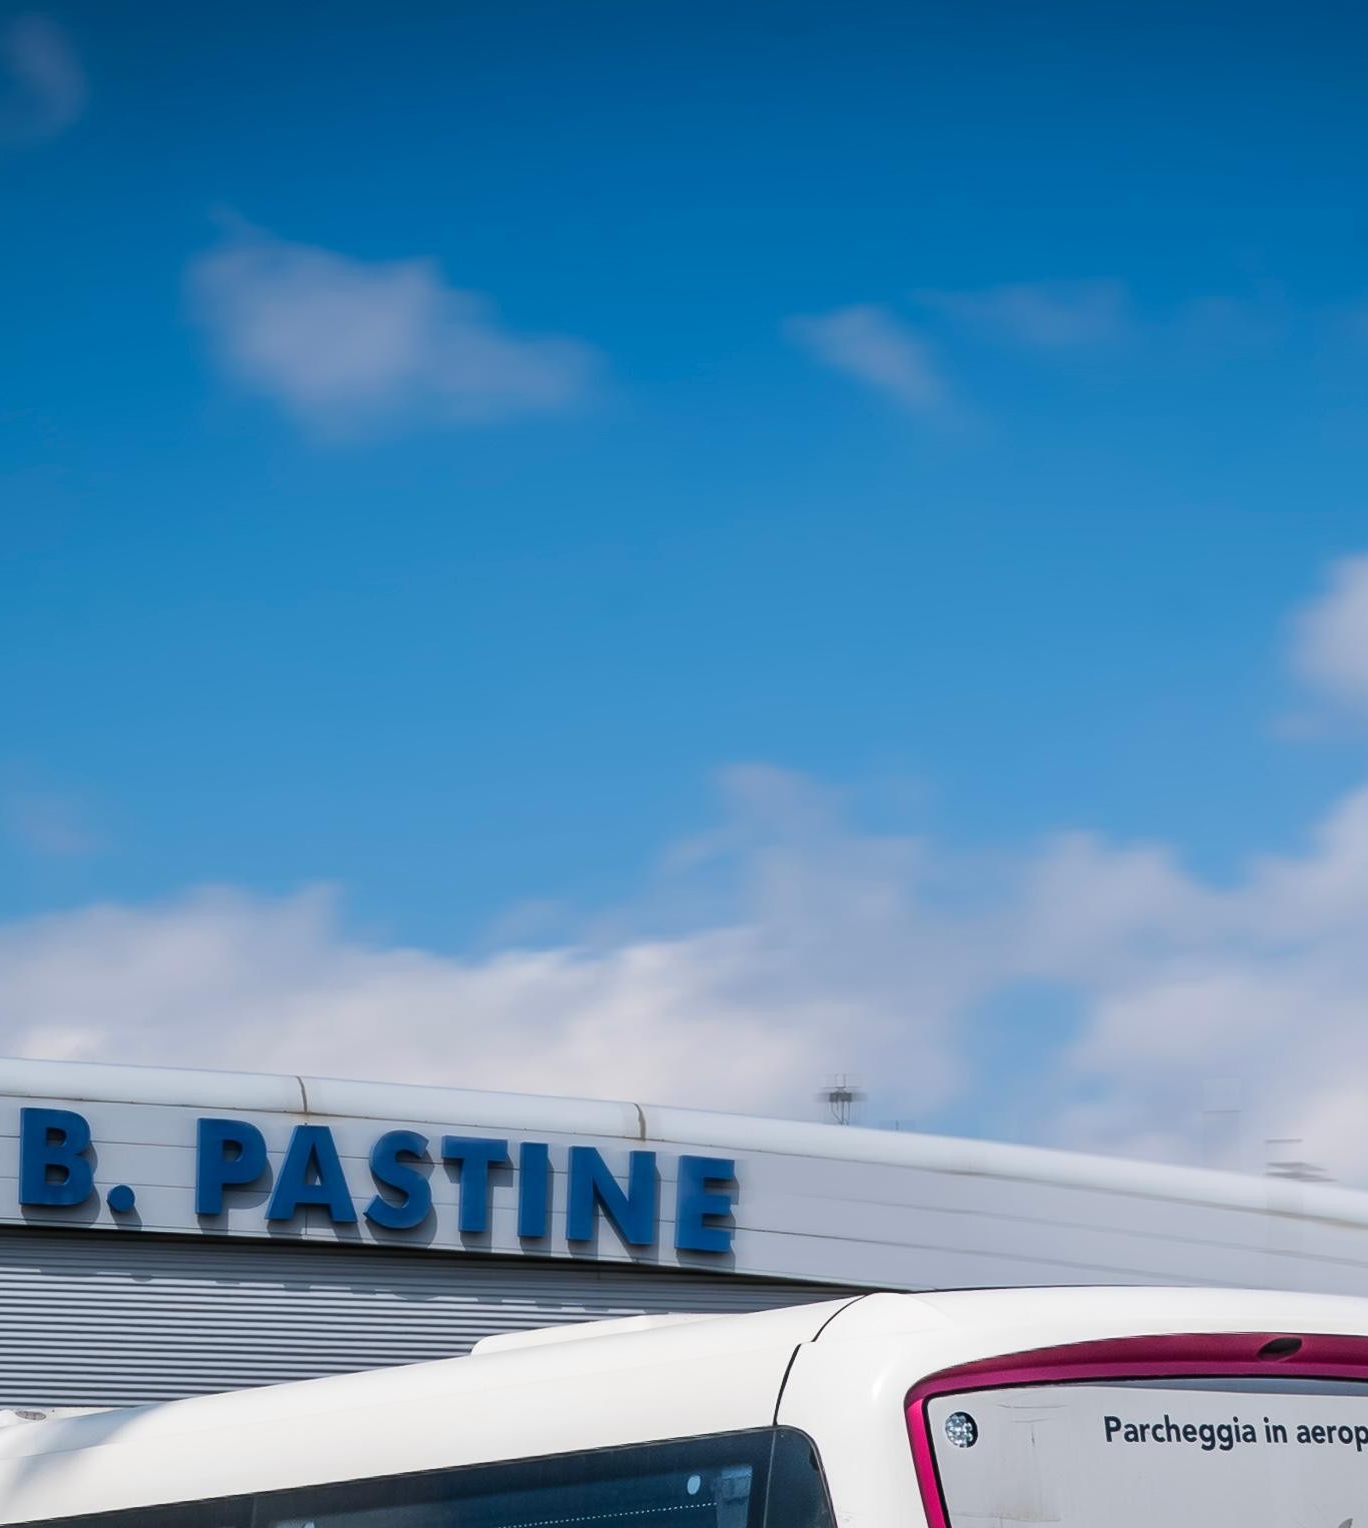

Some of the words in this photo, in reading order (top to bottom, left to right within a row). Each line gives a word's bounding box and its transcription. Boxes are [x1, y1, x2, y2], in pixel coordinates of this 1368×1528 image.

[18, 1106, 136, 1214] B.
[194, 1117, 737, 1252] PASTINE
[1103, 1414, 1257, 1451] Parcheggia
[1263, 1417, 1288, 1444] in
